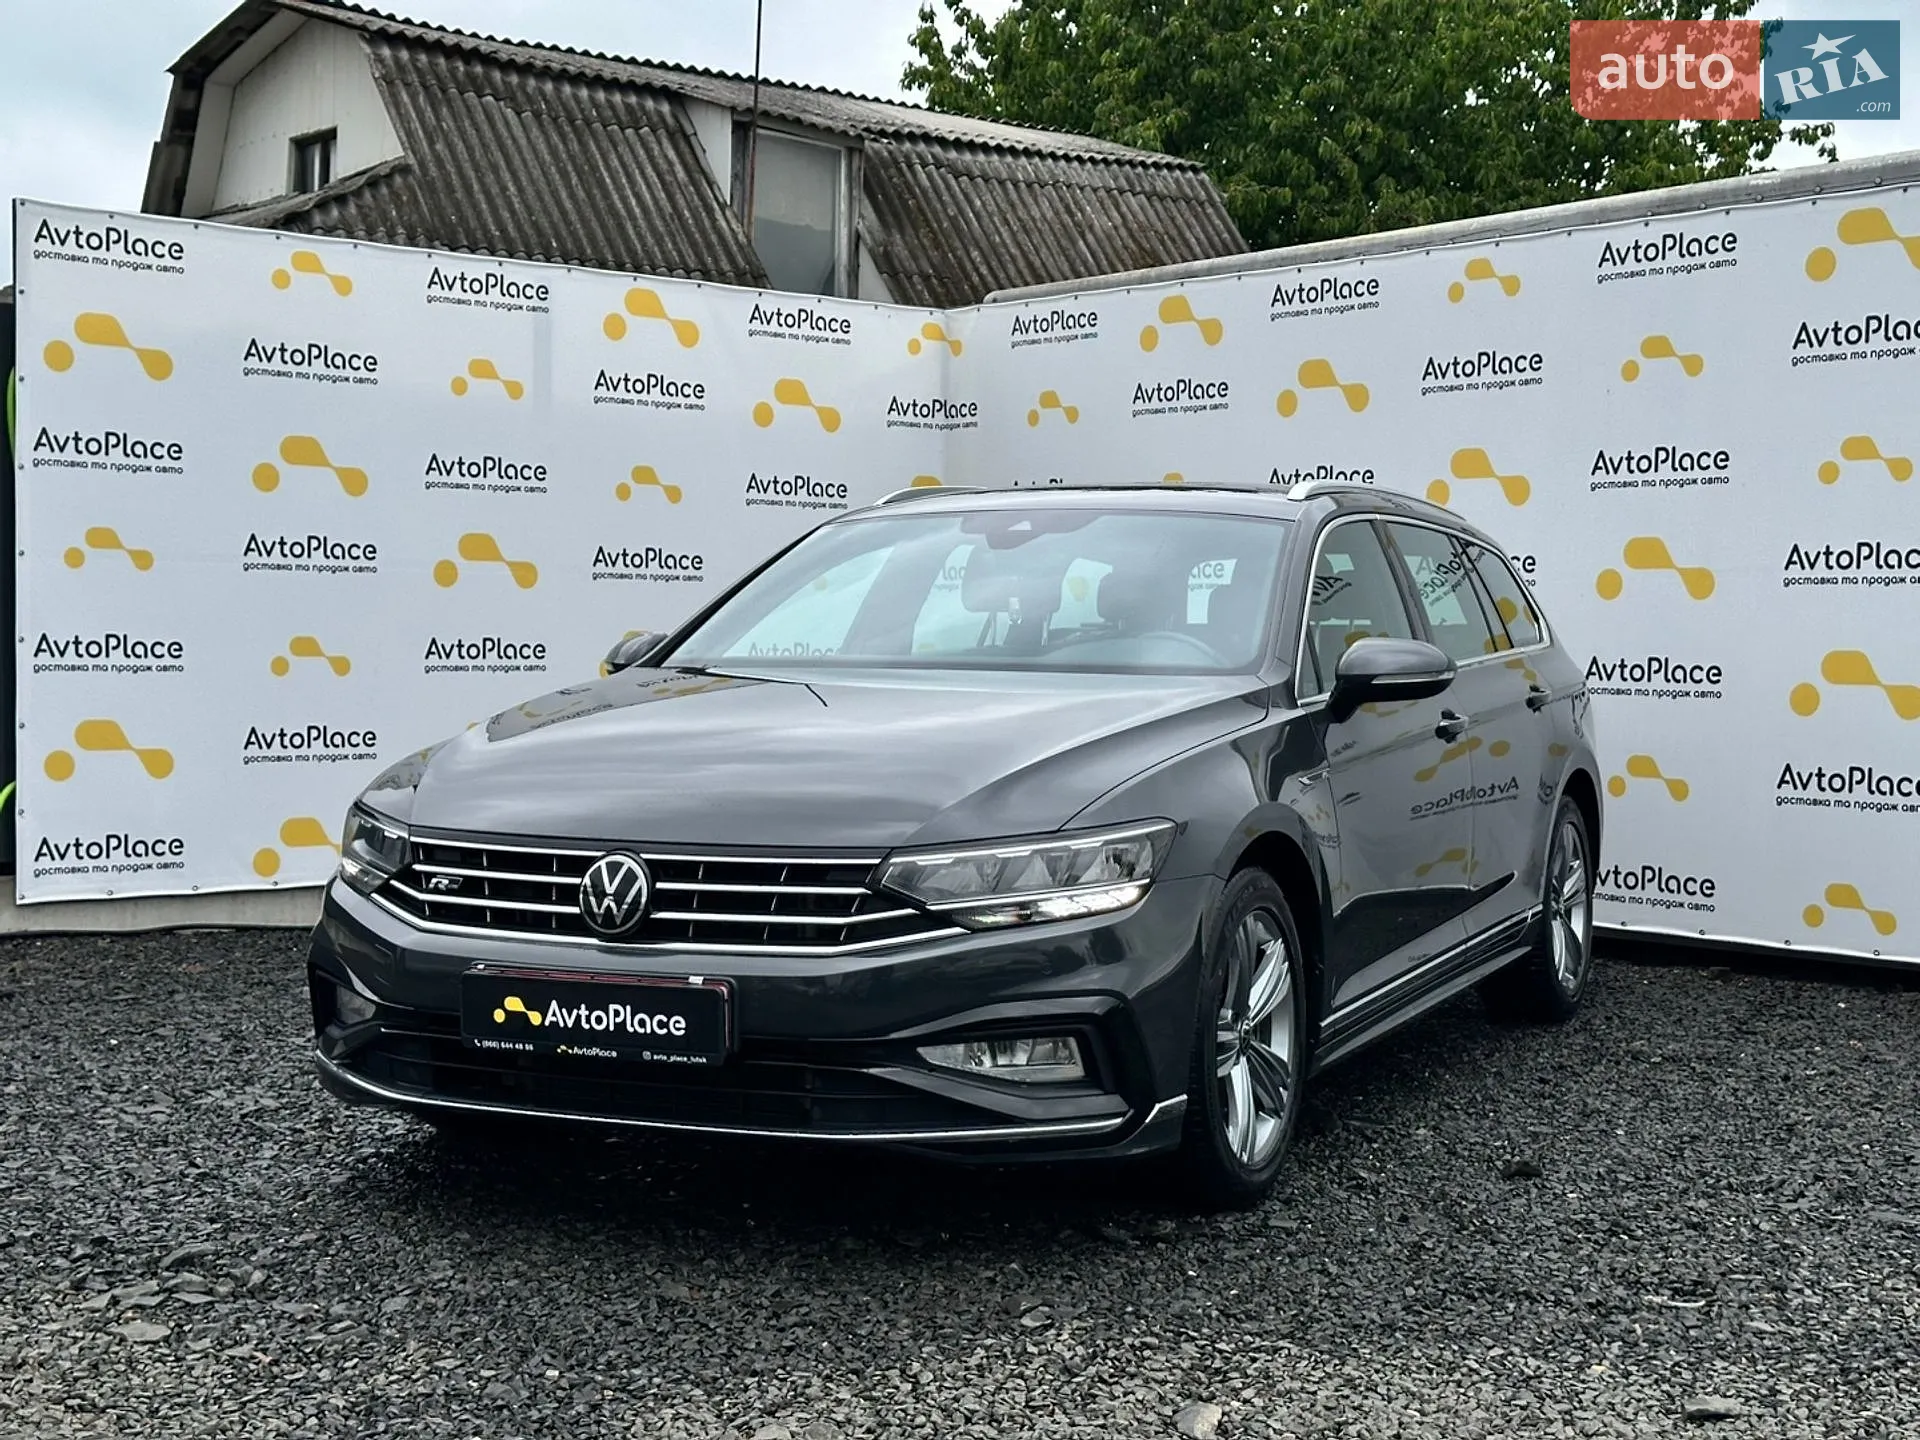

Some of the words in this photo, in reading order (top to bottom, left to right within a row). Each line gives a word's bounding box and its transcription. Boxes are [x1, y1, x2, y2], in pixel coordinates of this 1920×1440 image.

[34, 218, 184, 260] AvtoPlace
[1598, 232, 1737, 268] AvtoPlace
[33, 250, 89, 264] доставка
[92, 257, 108, 266] та
[111, 259, 153, 272] продаж
[156, 264, 184, 274] авто
[1597, 269, 1646, 284] доставка
[1648, 267, 1664, 276] та
[1666, 262, 1706, 276] продаж
[1708, 258, 1737, 269] авто
[427, 267, 549, 302] AvtoPlace
[1271, 277, 1379, 308] AvtoPlace
[426, 294, 472, 306] доставка
[474, 300, 488, 308] та
[490, 302, 524, 312] продаж
[526, 305, 549, 314] авто
[1270, 310, 1309, 322] доставка
[1324, 304, 1355, 316] продаж
[1357, 301, 1380, 310] авто
[748, 304, 851, 334] AvtoPlace
[1011, 310, 1098, 336] AvtoPlace
[244, 338, 378, 372] AvtoPlace
[1422, 350, 1543, 381] AvtoPlace
[1791, 352, 1848, 367] доставка
[1850, 351, 1868, 360] та
[1870, 347, 1916, 360] продаж
[243, 367, 293, 378] доставка
[295, 372, 310, 380] та
[312, 373, 350, 384] продаж
[352, 376, 378, 385] авто
[594, 369, 705, 400] AvtoPlace
[1421, 384, 1464, 396] доставка
[1482, 380, 1516, 391] продаж
[1518, 377, 1542, 386] авто
[1132, 378, 1229, 405] AvtoPlace
[888, 396, 978, 420] AvtoPlace
[33, 426, 183, 461] AvtoPlace
[32, 458, 88, 468] доставка
[91, 462, 108, 470] та
[110, 463, 152, 474] продаж
[155, 466, 184, 474] авто
[425, 453, 547, 482] AvtoPlace
[1591, 446, 1730, 476] AvtoPlace
[424, 481, 470, 490] доставка
[487, 484, 522, 494] продаж
[746, 472, 848, 499] AvtoPlace
[1590, 480, 1639, 492] доставка
[1659, 478, 1698, 489] продаж
[1700, 476, 1730, 485] авто
[243, 533, 377, 561] AvtoPlace
[592, 546, 703, 570] AvtoPlace
[243, 562, 293, 572] доставка
[295, 564, 310, 572] та
[312, 564, 350, 574] продаж
[1783, 576, 1838, 588] доставка
[1841, 576, 1858, 585] та
[1862, 576, 1906, 587] продаж
[33, 632, 183, 659] AvtoPlace
[425, 637, 546, 660] AvtoPlace
[33, 664, 89, 674] доставка
[92, 664, 108, 672] та
[111, 664, 153, 674] продаж
[155, 664, 184, 672] авто
[424, 665, 470, 674] доставка
[487, 664, 521, 674] продаж
[523, 664, 546, 672] авто
[1586, 656, 1722, 685] AvtoPlace
[1634, 688, 1650, 696] та
[1652, 689, 1691, 700] продаж
[1694, 690, 1722, 699] авто
[244, 725, 377, 750] AvtoPlace
[243, 755, 293, 765] доставка
[295, 754, 310, 762] та
[312, 754, 350, 763] продаж
[351, 752, 377, 760] авто
[1776, 796, 1831, 807] доставка
[1834, 800, 1851, 808] та
[1854, 801, 1898, 813] продаж
[34, 834, 184, 862] AvtoPlace
[34, 866, 89, 878] доставка
[92, 865, 109, 873] та
[111, 863, 154, 874] продаж
[156, 862, 185, 870] авто
[1598, 864, 1716, 898] vtoPlace
[1628, 896, 1644, 904] та
[1646, 898, 1685, 909] продаж
[1687, 902, 1715, 912] авто
[544, 999, 687, 1036] AvtoPlace
[573, 1046, 617, 1057] AvtoPlace
